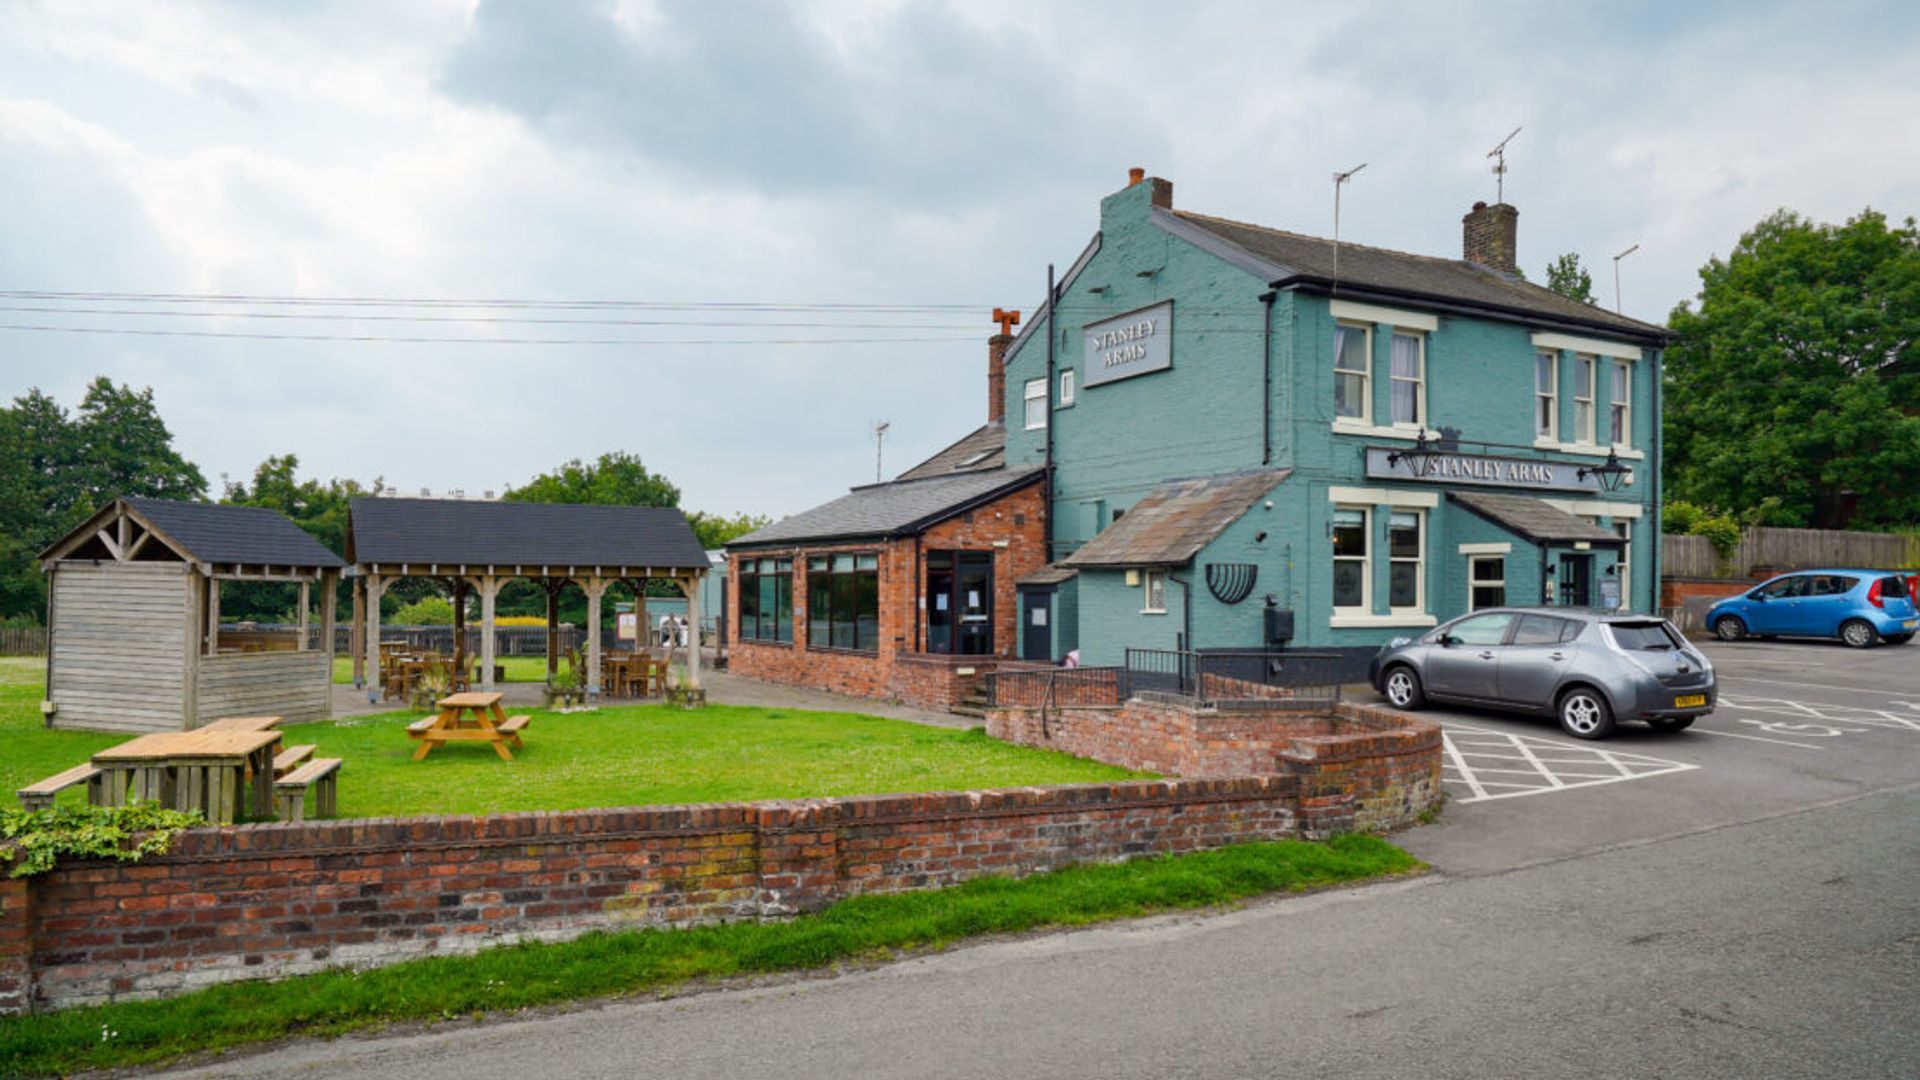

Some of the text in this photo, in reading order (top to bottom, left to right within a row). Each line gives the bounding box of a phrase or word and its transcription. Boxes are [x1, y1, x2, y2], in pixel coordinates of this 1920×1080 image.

[1093, 319, 1156, 351] STANLEY
[1105, 344, 1146, 366] ARMS
[1430, 455, 1553, 482] STANLEY ARMS
